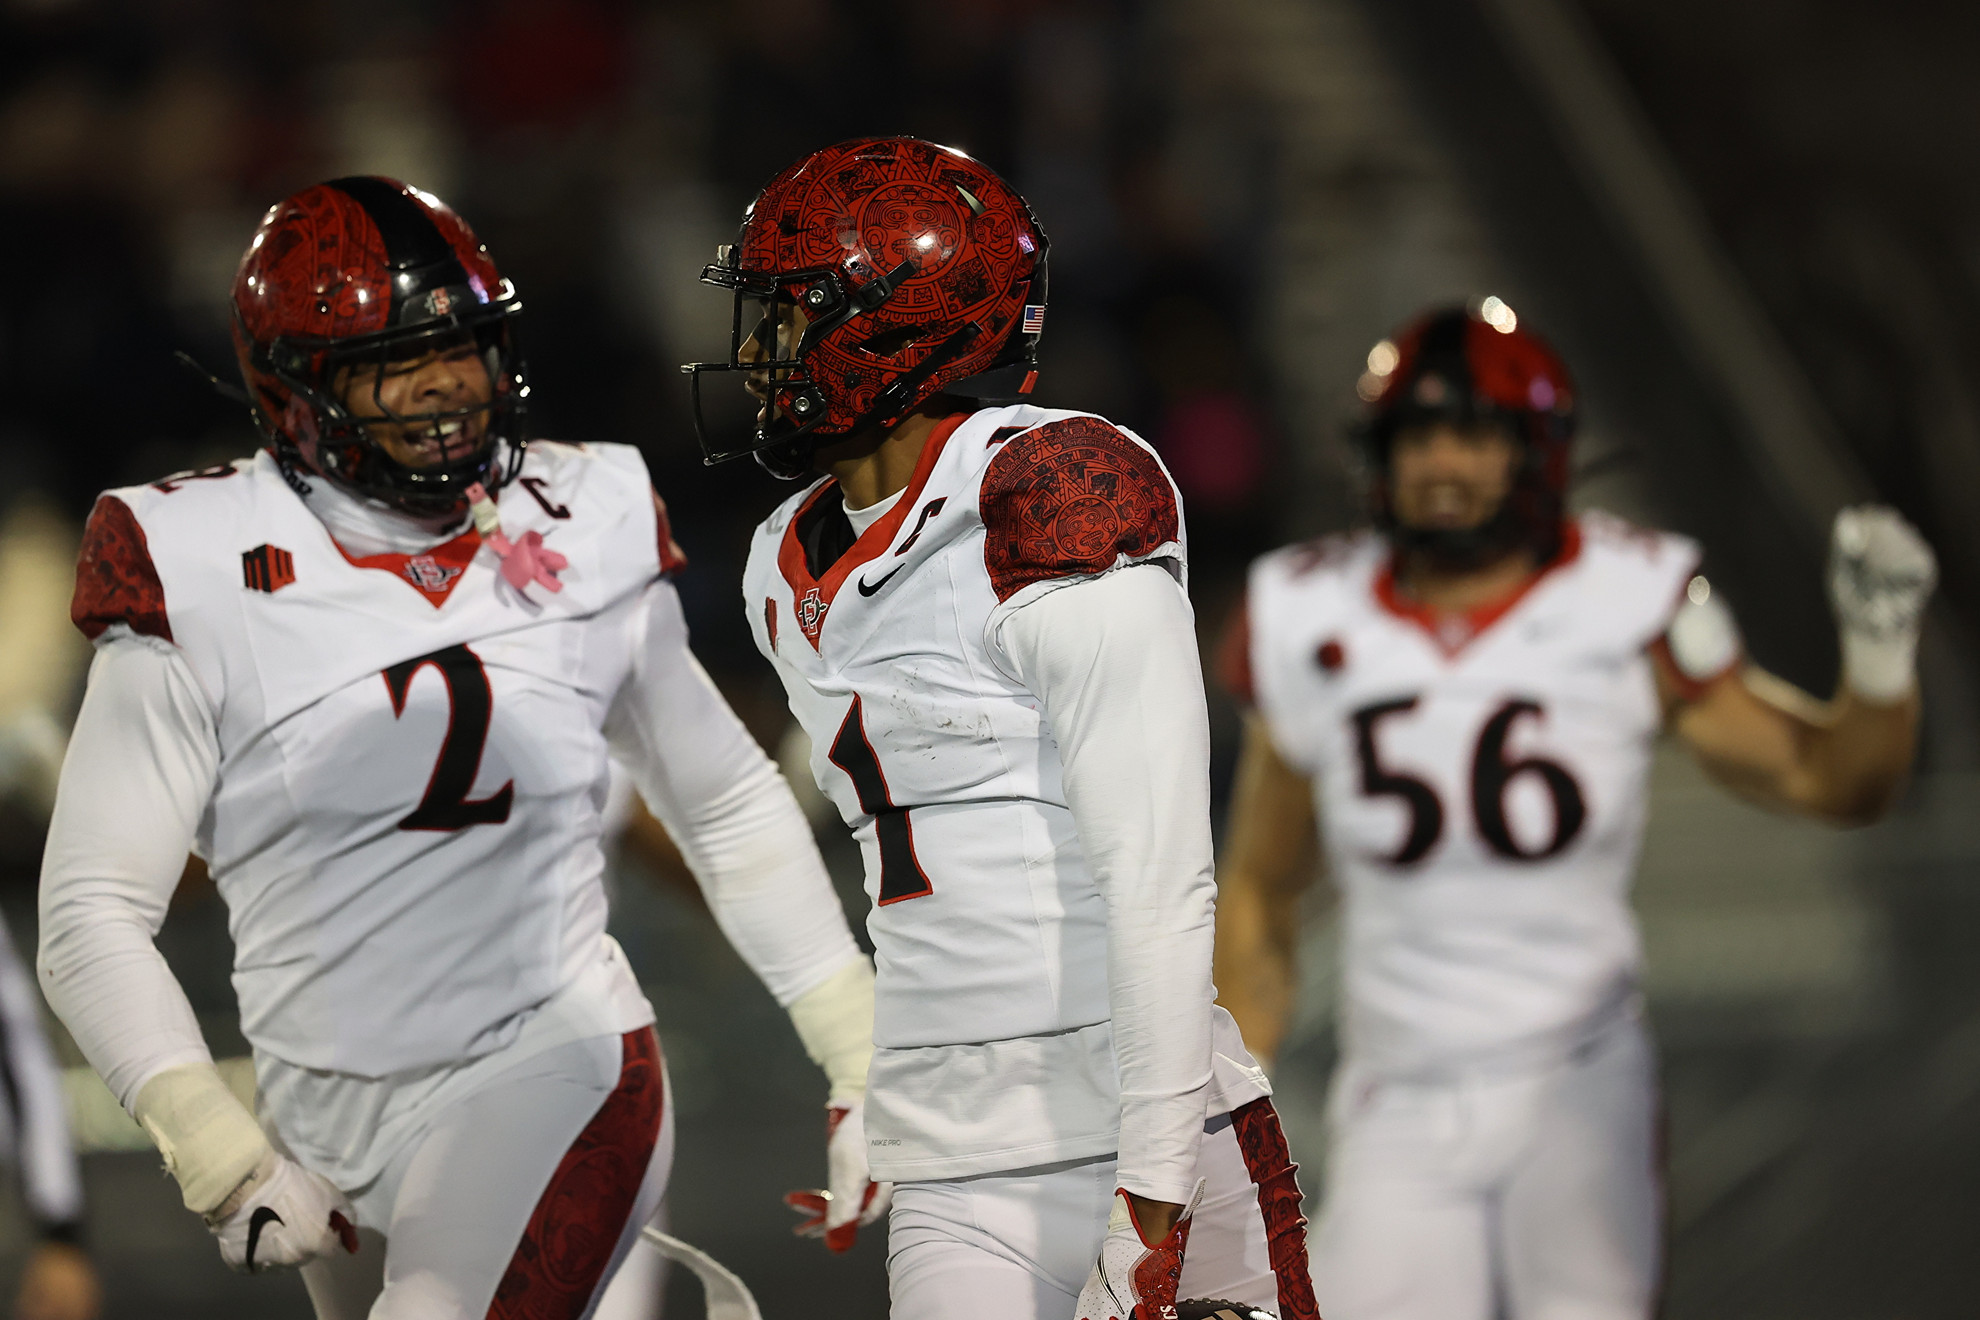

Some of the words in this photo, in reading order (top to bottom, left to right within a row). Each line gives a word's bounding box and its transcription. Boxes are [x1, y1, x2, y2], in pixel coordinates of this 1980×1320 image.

[519, 477, 571, 519] C
[895, 497, 947, 556] C
[382, 643, 513, 830] 2
[828, 691, 933, 906] 1
[1352, 694, 1586, 866] 56
